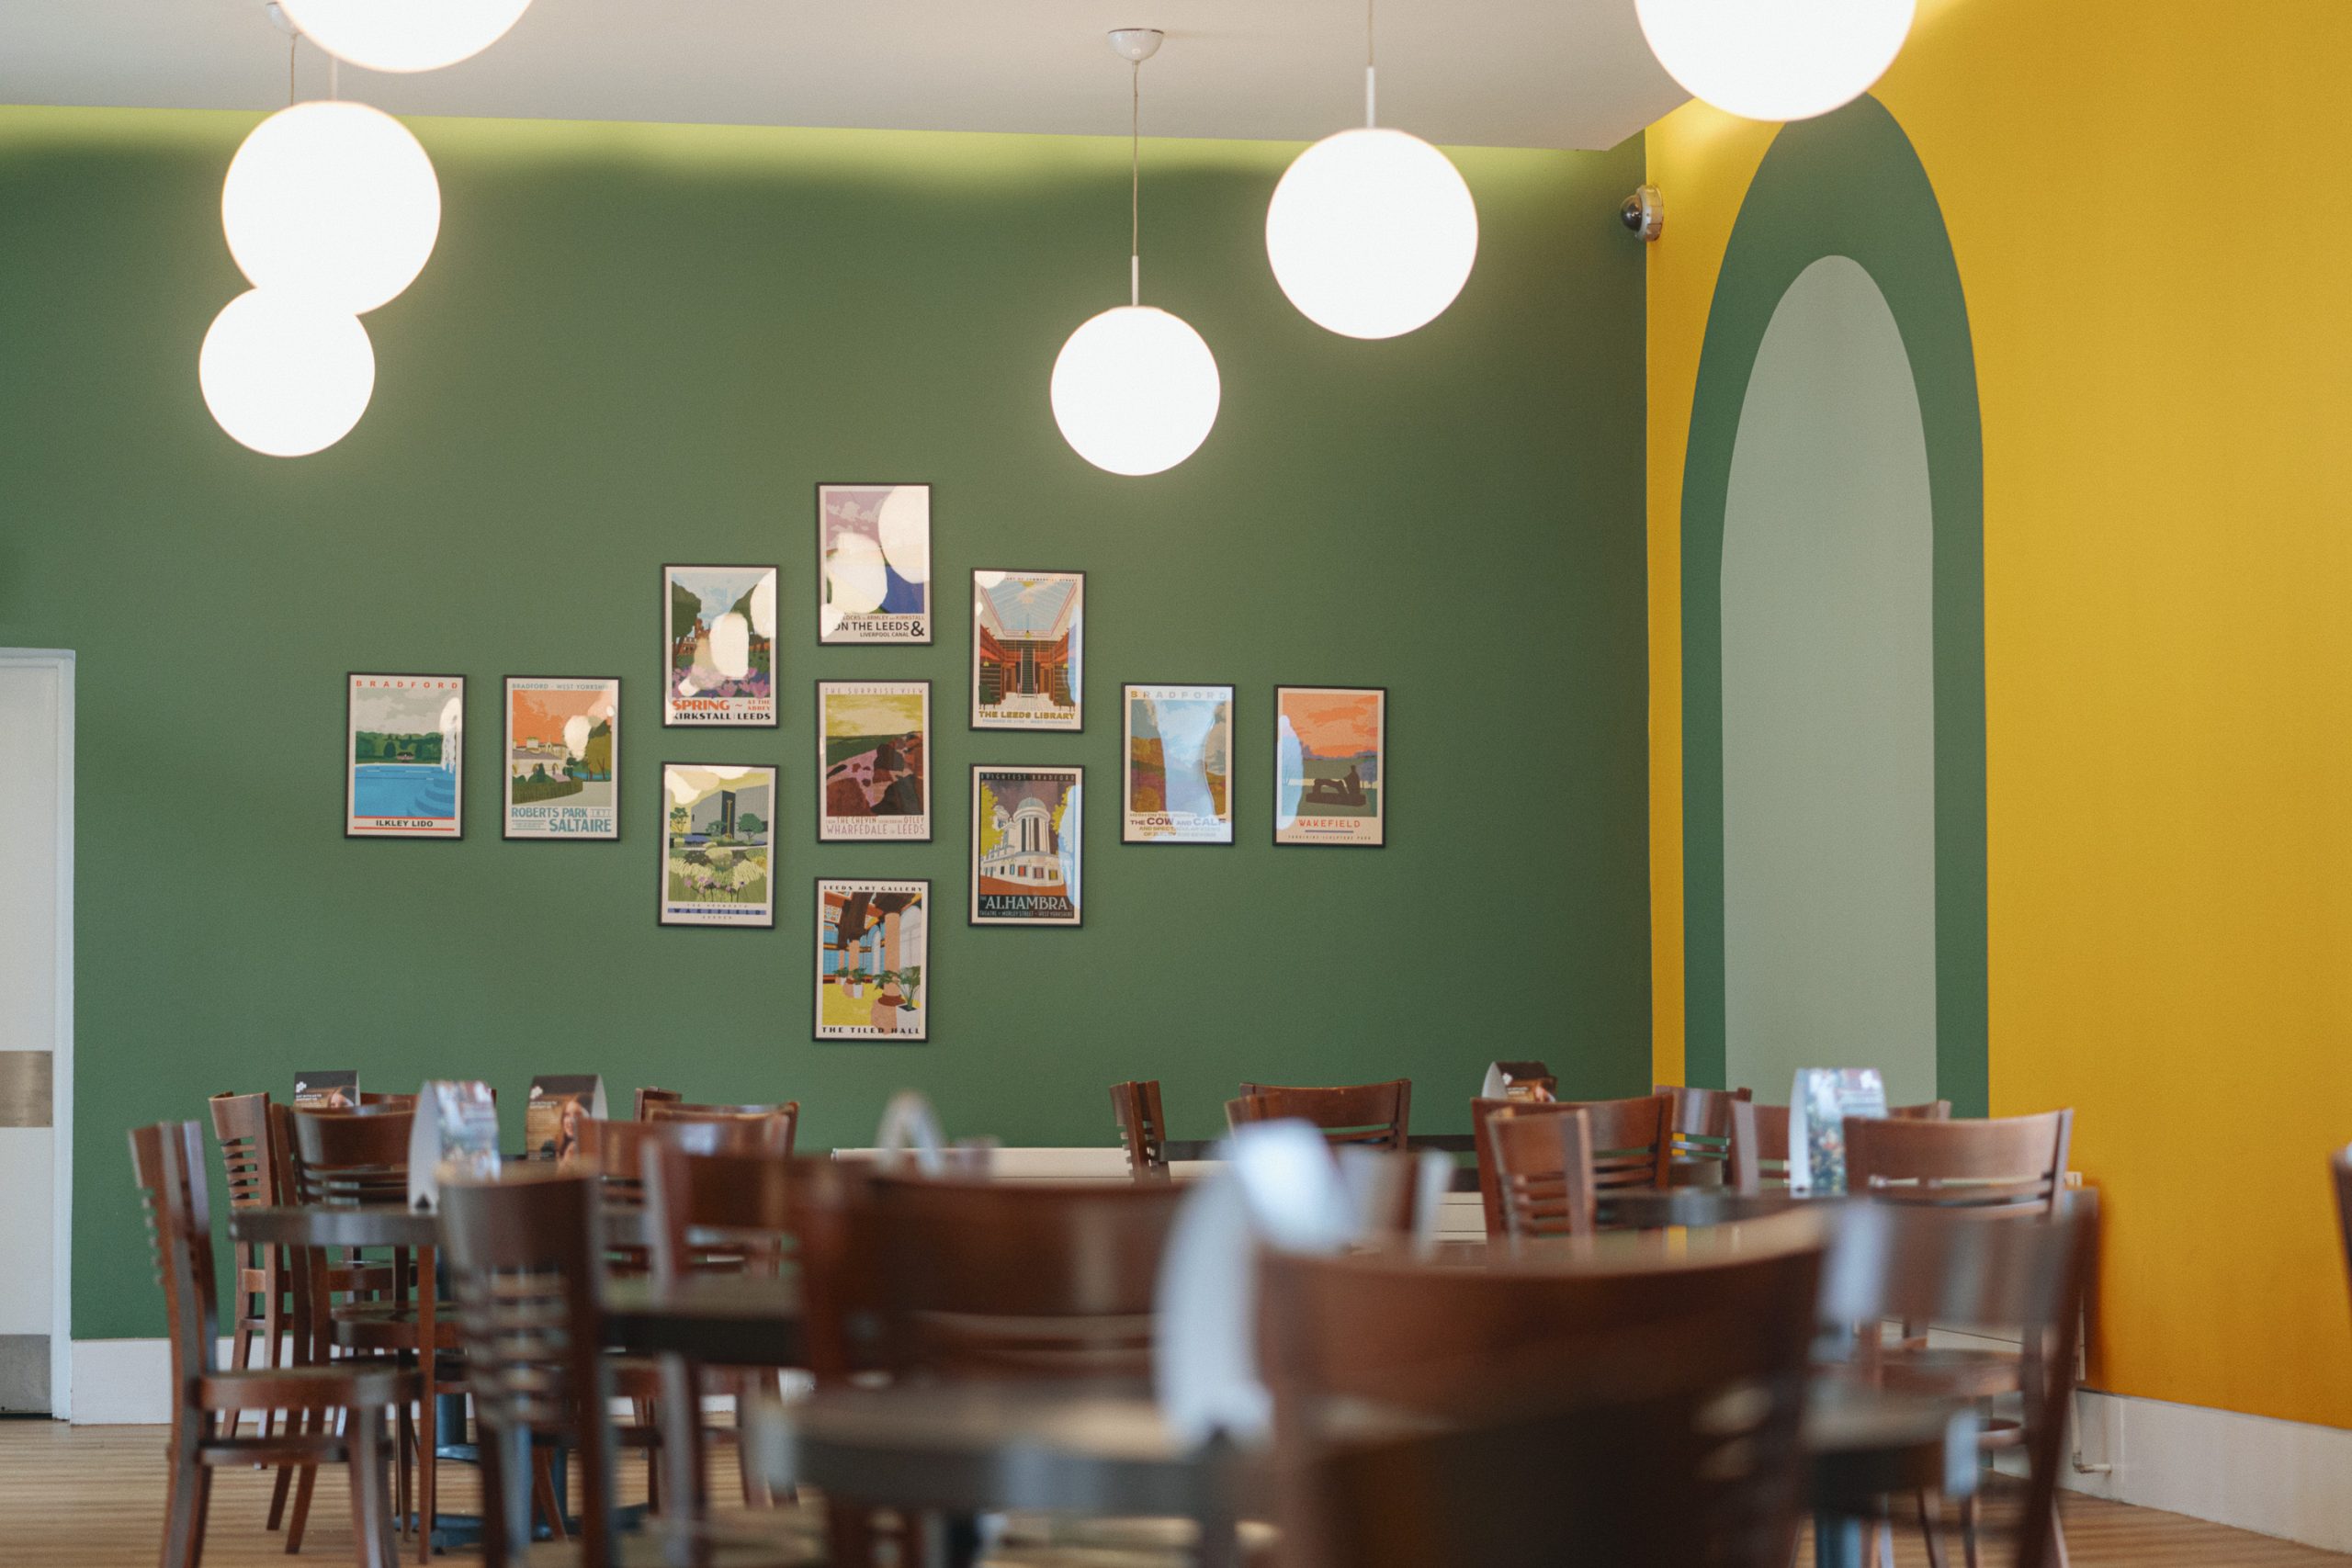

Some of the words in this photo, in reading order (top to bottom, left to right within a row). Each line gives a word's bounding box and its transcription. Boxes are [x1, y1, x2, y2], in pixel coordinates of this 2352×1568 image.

[852, 621, 873, 631] THE
[876, 621, 910, 631] LEEDS
[910, 620, 925, 637] &
[356, 680, 458, 689] BRADFORD
[1130, 690, 1227, 699] BRADFORD
[672, 699, 730, 711] SPRING
[737, 712, 771, 720] LEEDS
[978, 710, 998, 718] THE
[1001, 710, 1031, 719] LEEDS
[1034, 711, 1074, 720] LIBRARY
[511, 807, 560, 818] ROBERTS
[562, 807, 588, 818] PARK
[548, 818, 612, 832] SALTAIRE
[1147, 817, 1173, 826] COW
[1299, 819, 1361, 828] WAKEFIELD
[826, 824, 888, 835] WHARFEDALE
[897, 824, 925, 835] LEEDS
[985, 896, 1068, 909] ALHAMBRA
